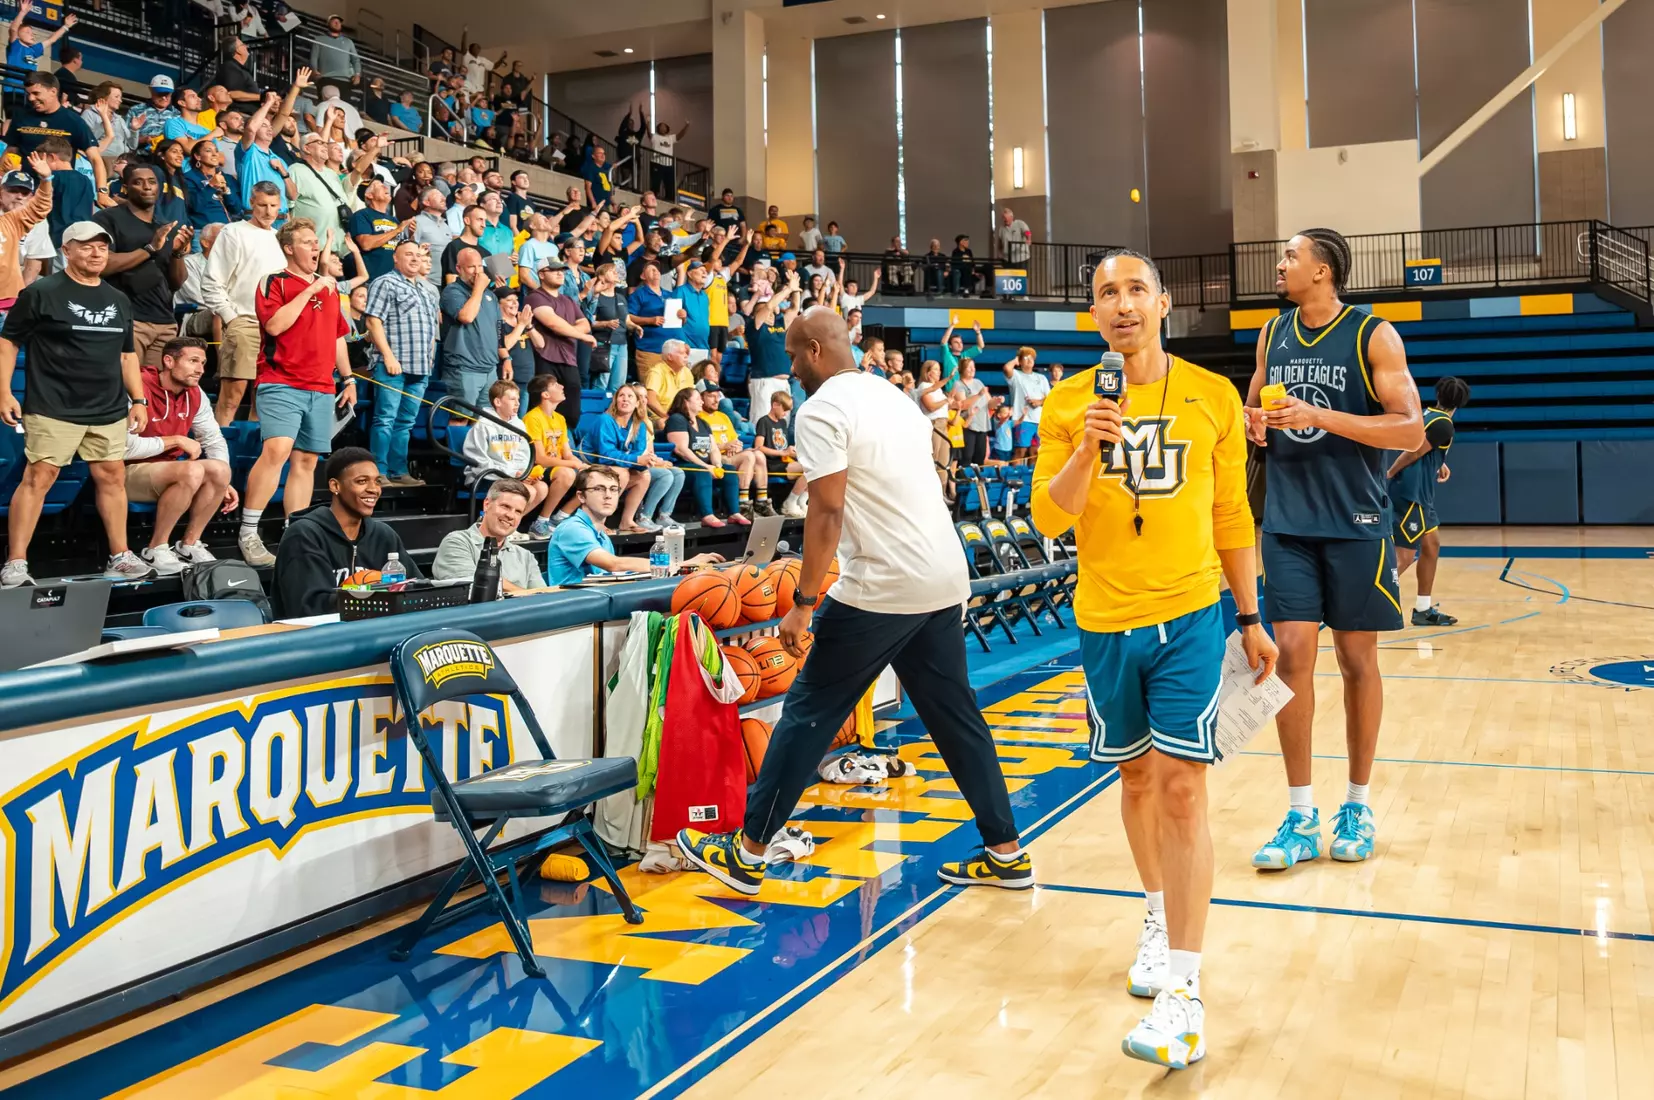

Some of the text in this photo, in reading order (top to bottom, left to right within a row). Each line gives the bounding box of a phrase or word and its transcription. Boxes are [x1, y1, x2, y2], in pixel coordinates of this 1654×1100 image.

[1412, 268, 1434, 281] 107
[1002, 278, 1023, 291] 106
[1289, 357, 1323, 365] MARQUETTE
[1099, 372, 1118, 390] MU
[1269, 364, 1347, 392] GOLDEN EAGLES
[1104, 419, 1186, 494] MU
[418, 643, 493, 677] MARQUETTE
[757, 654, 785, 671] LITE
[25, 695, 501, 965] MARQUETTE
